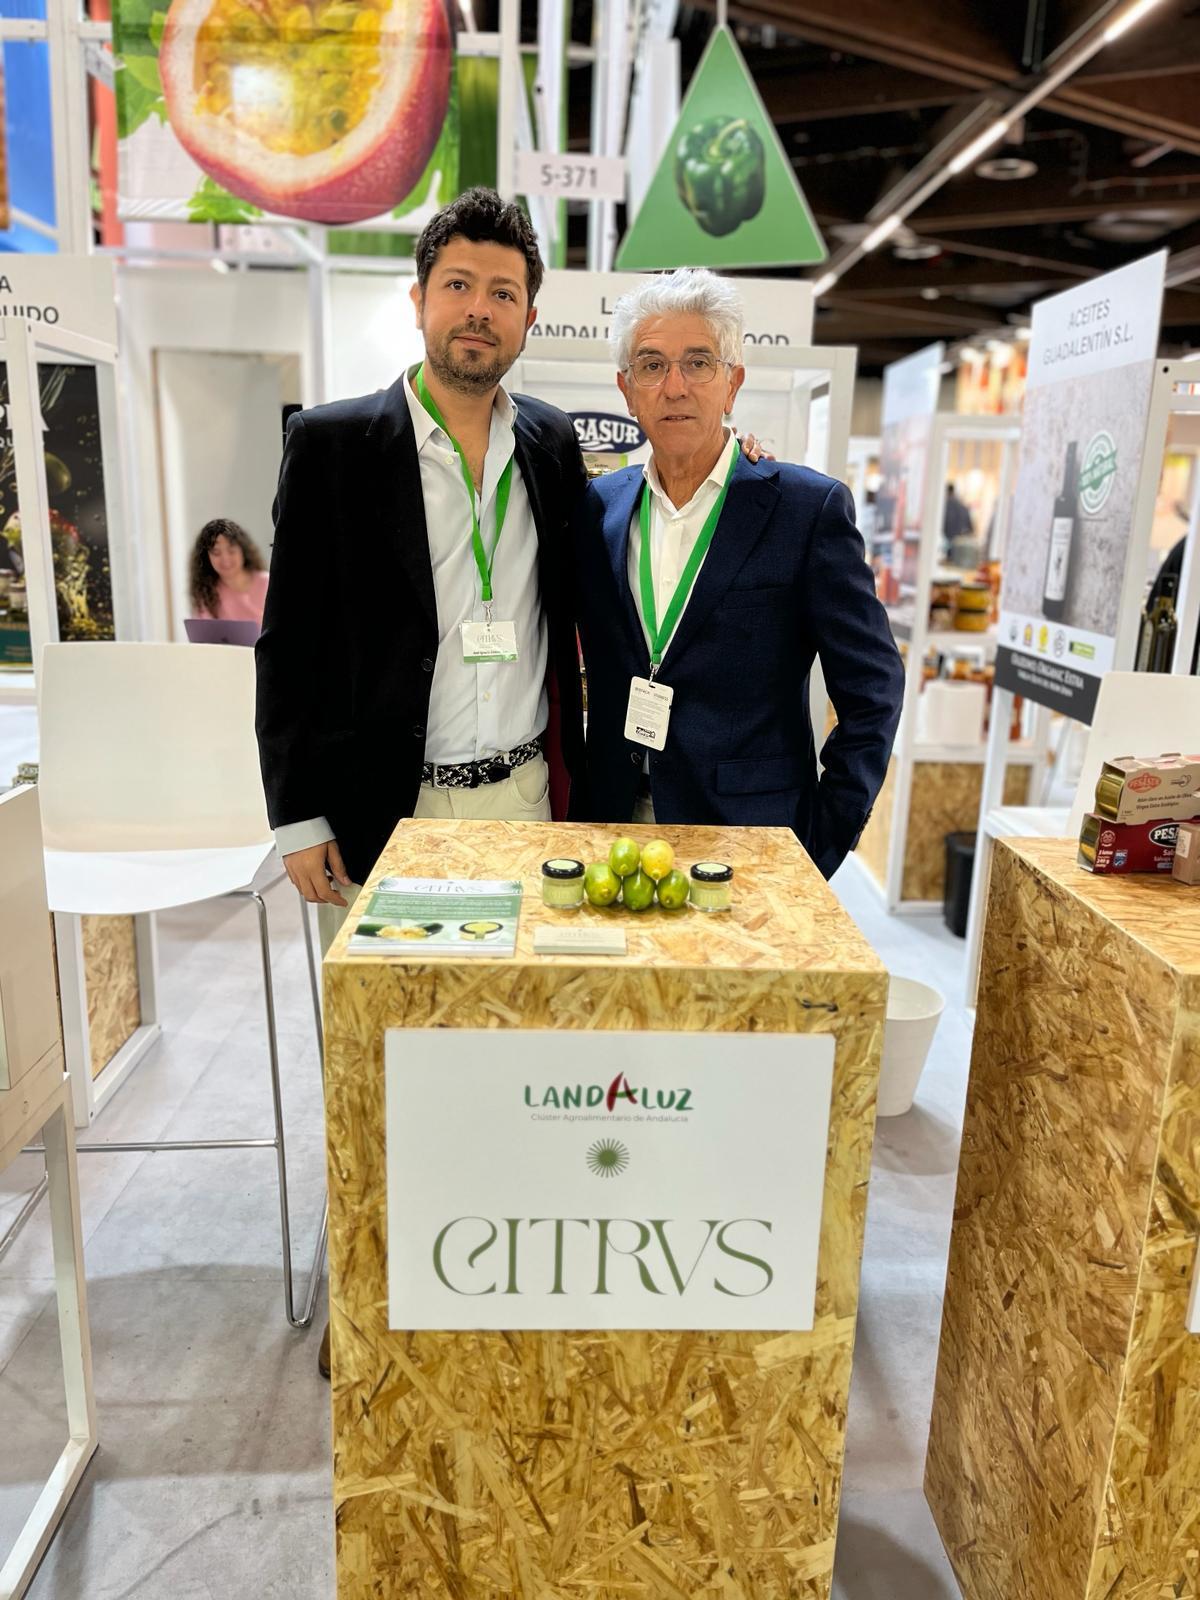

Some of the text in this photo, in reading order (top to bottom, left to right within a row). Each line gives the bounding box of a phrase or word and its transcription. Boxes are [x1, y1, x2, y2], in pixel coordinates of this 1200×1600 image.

[541, 164, 597, 188] S-371
[1068, 299, 1111, 329] ACEITES
[1113, 323, 1134, 346] S.L.
[524, 1071, 694, 1112] LANDALUZ
[531, 1112, 561, 1121] Clúster
[563, 1112, 632, 1123] Agroalimentario
[633, 1113, 644, 1122] de
[433, 1216, 774, 1297] CITRVS
